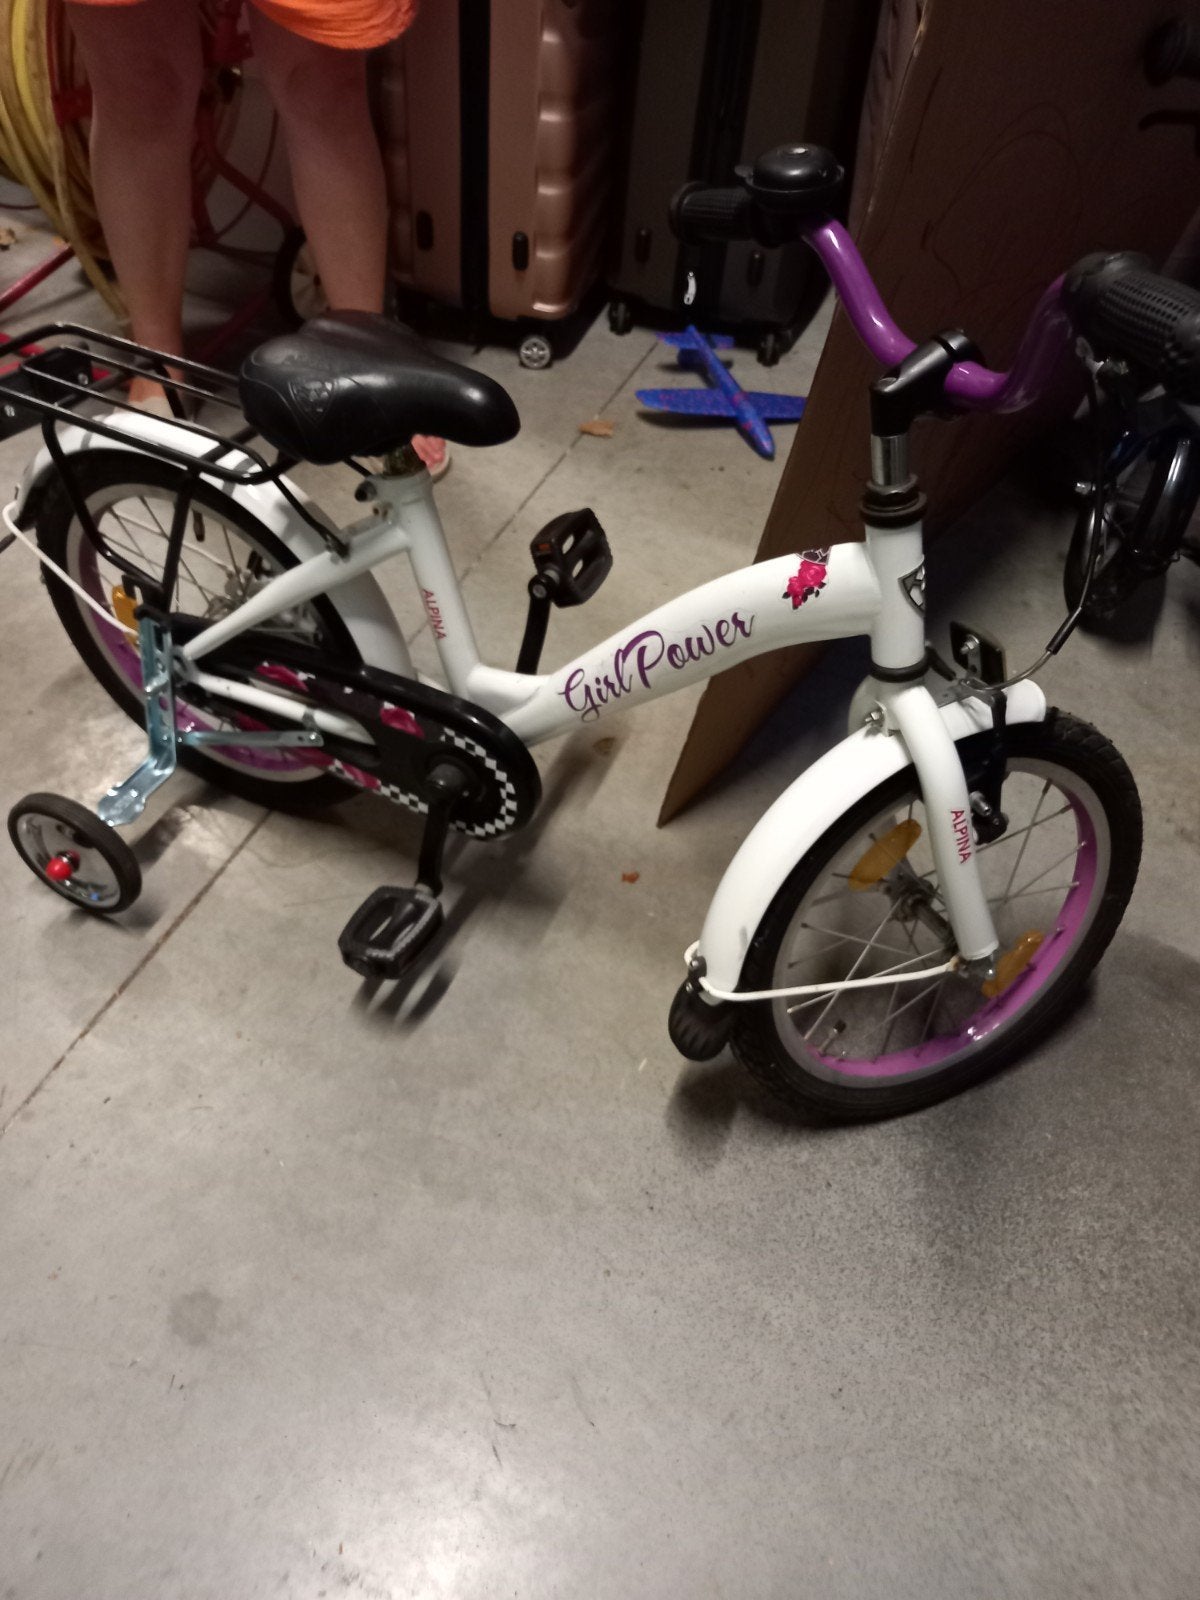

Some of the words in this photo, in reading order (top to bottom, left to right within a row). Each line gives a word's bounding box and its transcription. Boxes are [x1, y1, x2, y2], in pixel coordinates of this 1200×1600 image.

[422, 588, 447, 640] ALPINA
[558, 648, 633, 723] Girl
[621, 612, 756, 689] Power
[950, 809, 972, 865] ALPINA
